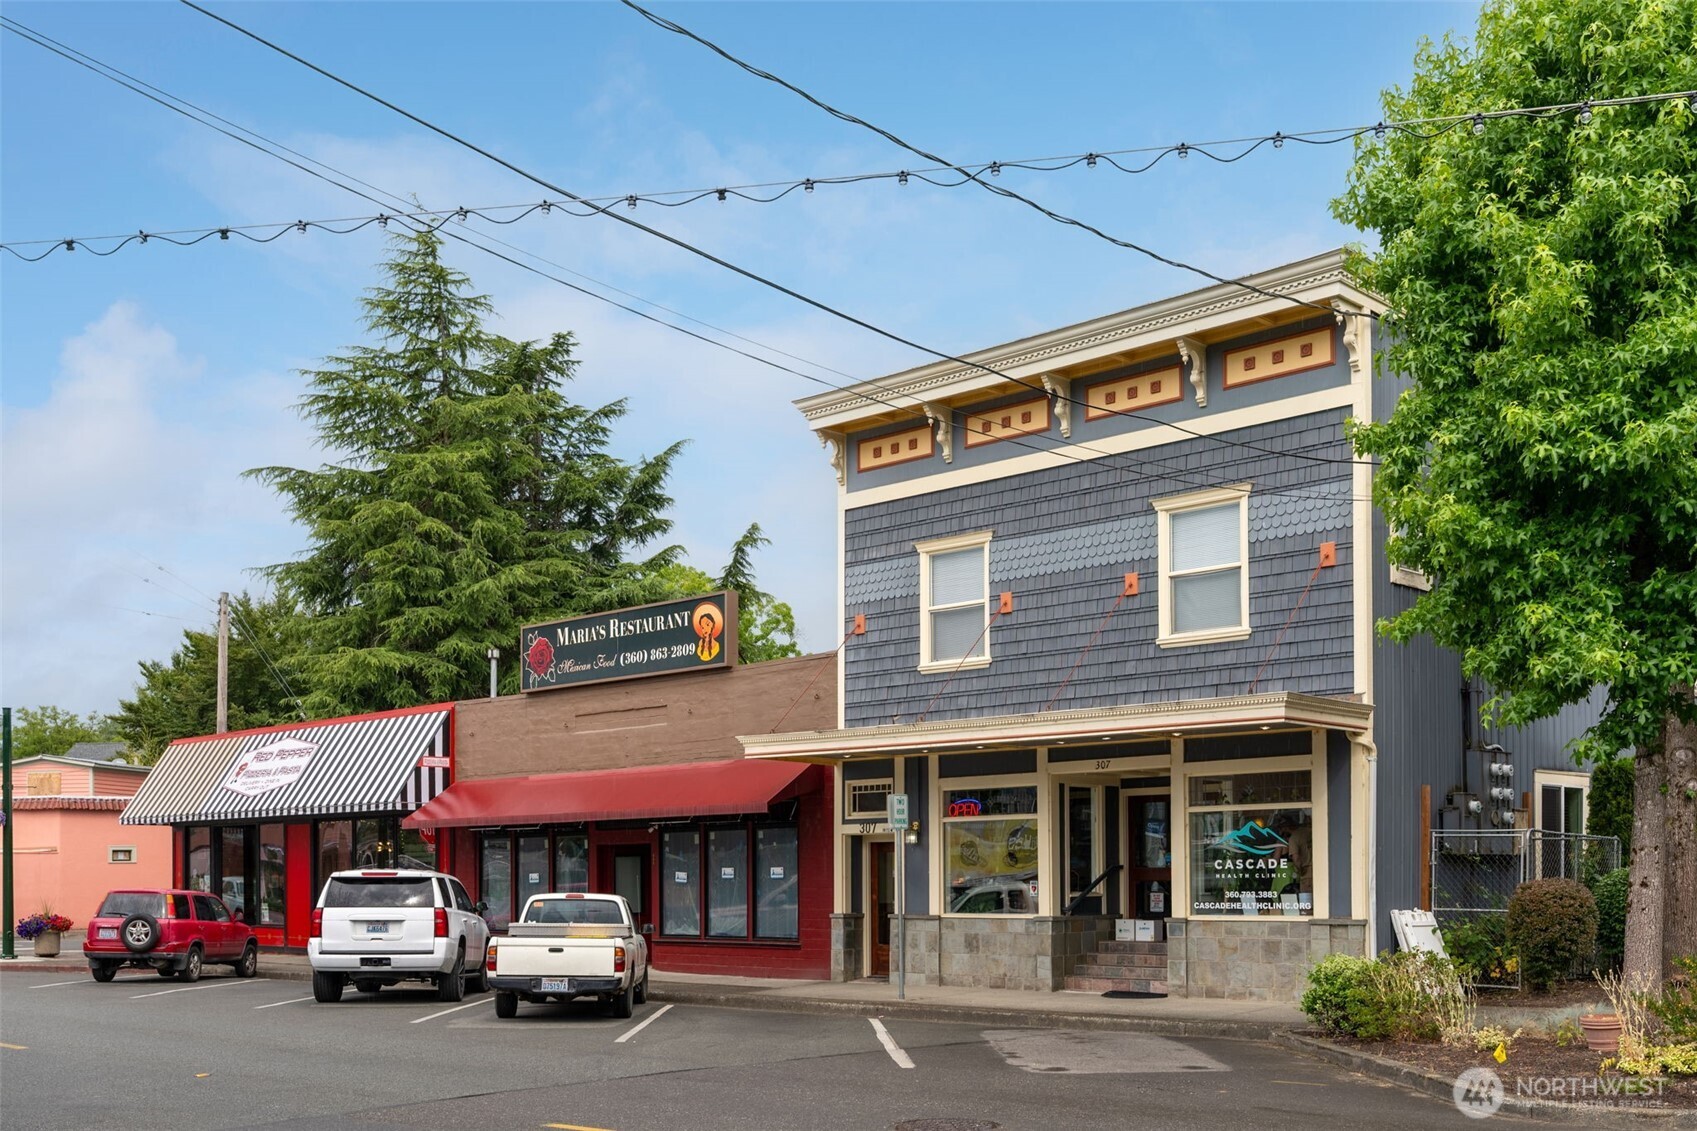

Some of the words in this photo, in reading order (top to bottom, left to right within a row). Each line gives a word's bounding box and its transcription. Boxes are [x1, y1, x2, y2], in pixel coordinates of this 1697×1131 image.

[557, 624, 606, 647] MARIA'S
[609, 610, 691, 639] RESTAURANT
[557, 658, 591, 675] Mexican
[592, 653, 618, 670] Food
[620, 649, 648, 667] (360)
[650, 642, 696, 662] 863-2809
[251, 751, 274, 763] RED
[272, 747, 314, 761] PEPPER
[1095, 760, 1111, 770] 307
[948, 803, 980, 817] OPEN
[859, 822, 877, 834] 307
[1214, 858, 1288, 870] CASCADE
[1224, 891, 1278, 899] 360.793.3883
[1193, 902, 1312, 910] CASCADEHEALTHCLINIC.ORG
